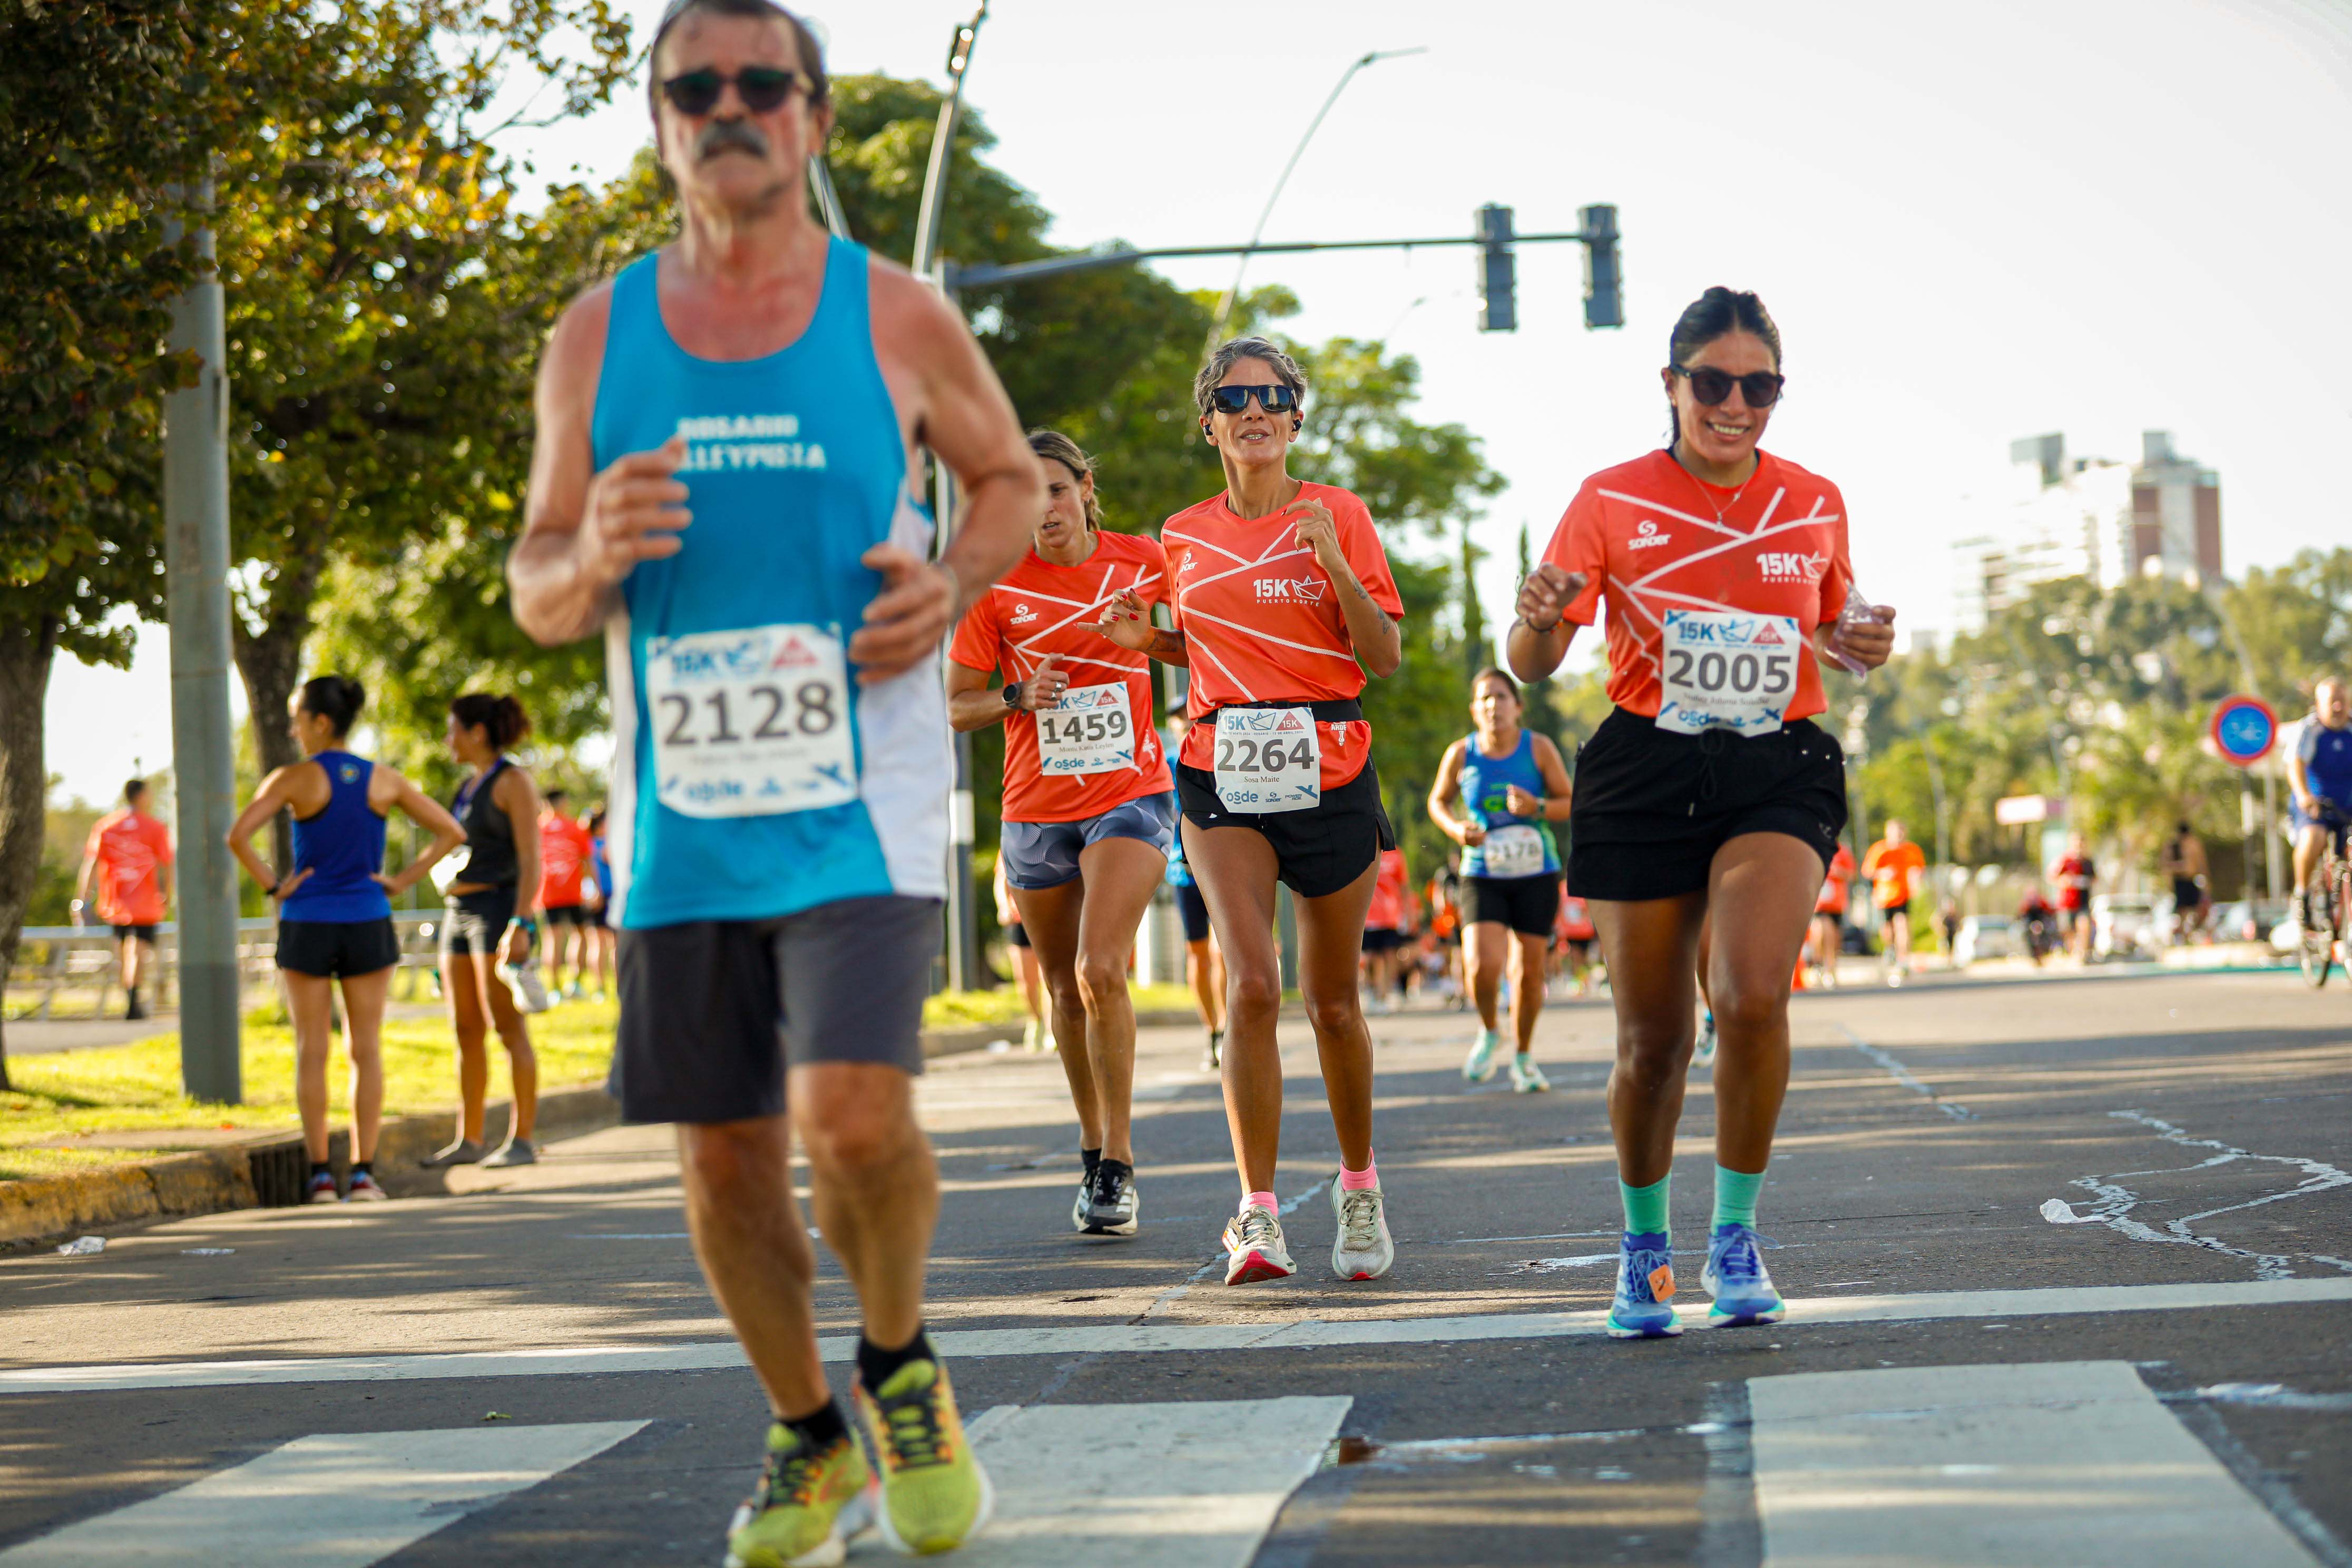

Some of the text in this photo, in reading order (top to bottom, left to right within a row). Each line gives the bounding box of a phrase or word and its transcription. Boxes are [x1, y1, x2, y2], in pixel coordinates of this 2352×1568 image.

[1756, 553, 1801, 576] 15K
[1253, 579, 1290, 597] 15K
[1293, 599, 1320, 607] NORTE
[1678, 621, 1714, 641] 15K
[1668, 649, 1791, 694] 2005
[1101, 695, 1114, 704] 15K
[659, 681, 837, 747] 2128
[1042, 710, 1128, 744] 1459
[1223, 716, 1246, 731] 15K
[1282, 720, 1298, 728] 15K
[1054, 758, 1085, 770] osde
[1217, 738, 1315, 773] 2264
[1226, 790, 1259, 805] osde
